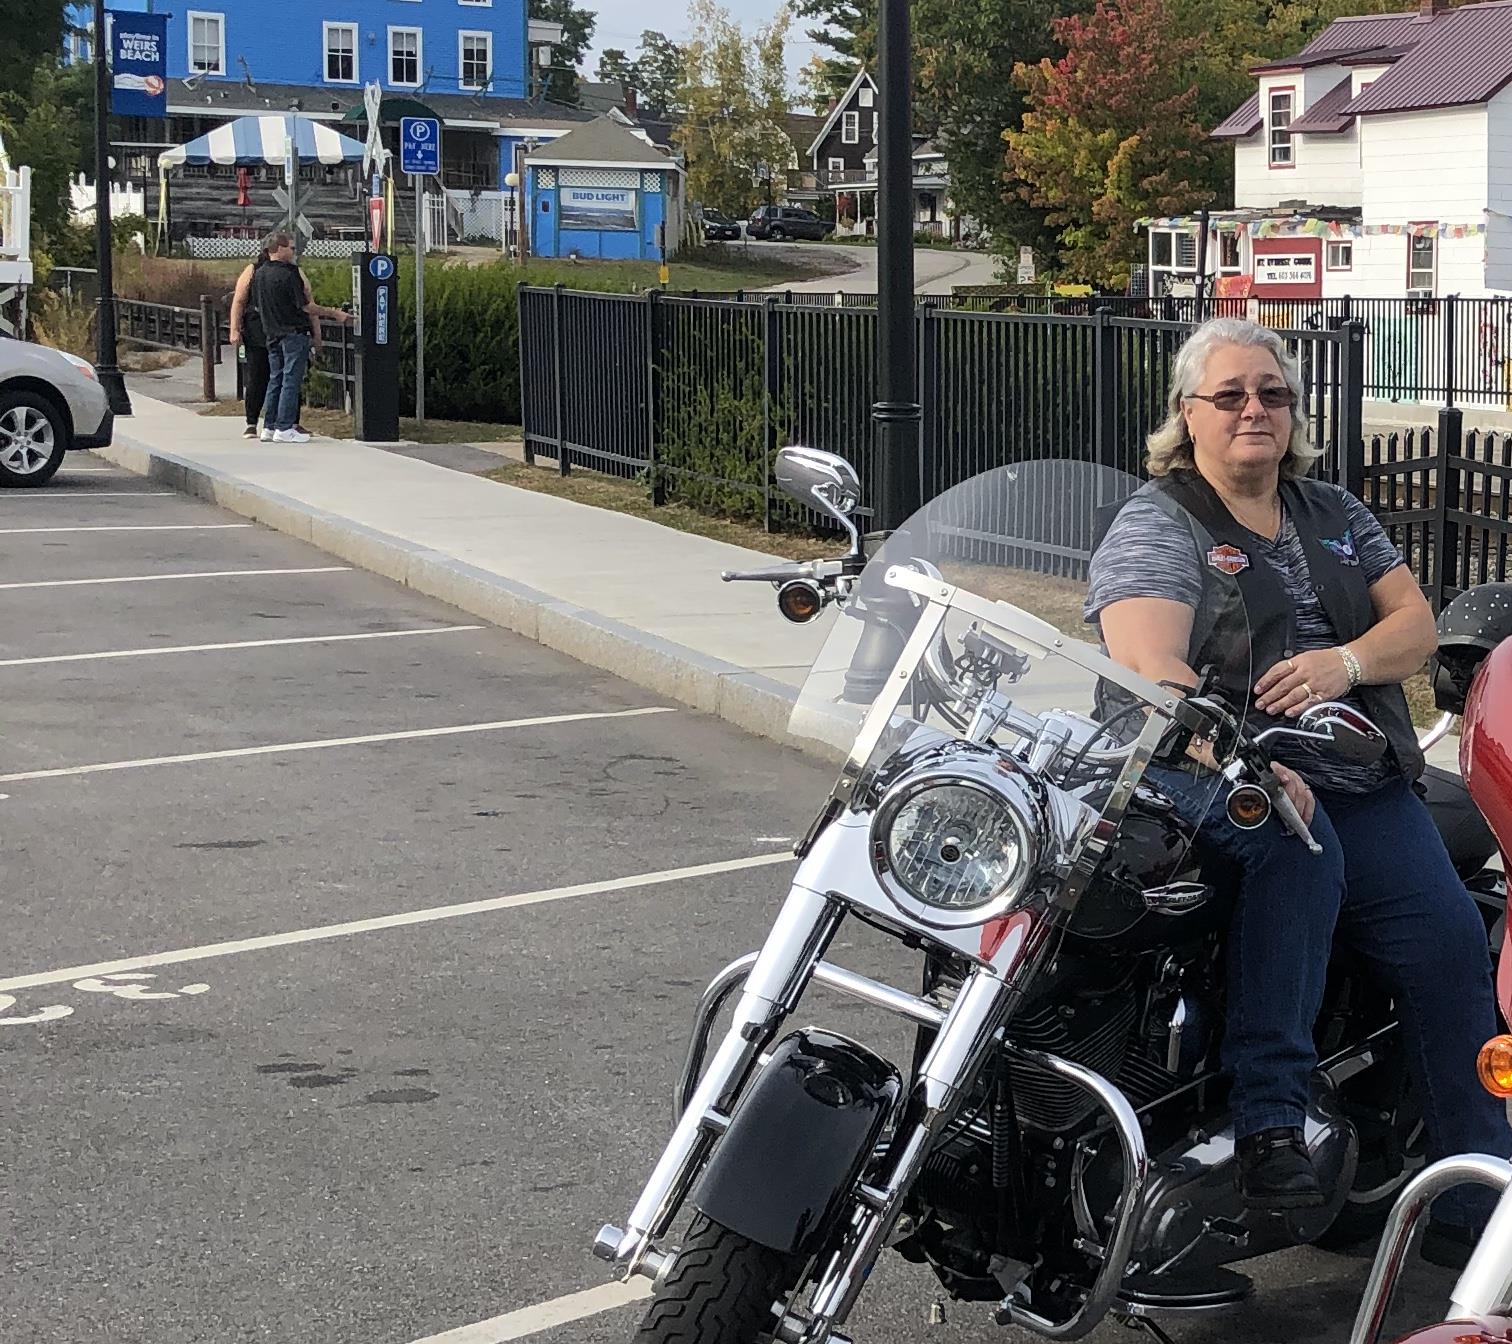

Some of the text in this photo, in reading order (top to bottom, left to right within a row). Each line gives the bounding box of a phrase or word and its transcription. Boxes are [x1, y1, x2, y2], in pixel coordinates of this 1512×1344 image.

[123, 39, 157, 52] WEIRS
[120, 49, 160, 62] BEACH
[416, 125, 426, 137] P
[572, 191, 626, 202] BUD LIGHT
[377, 259, 388, 275] P
